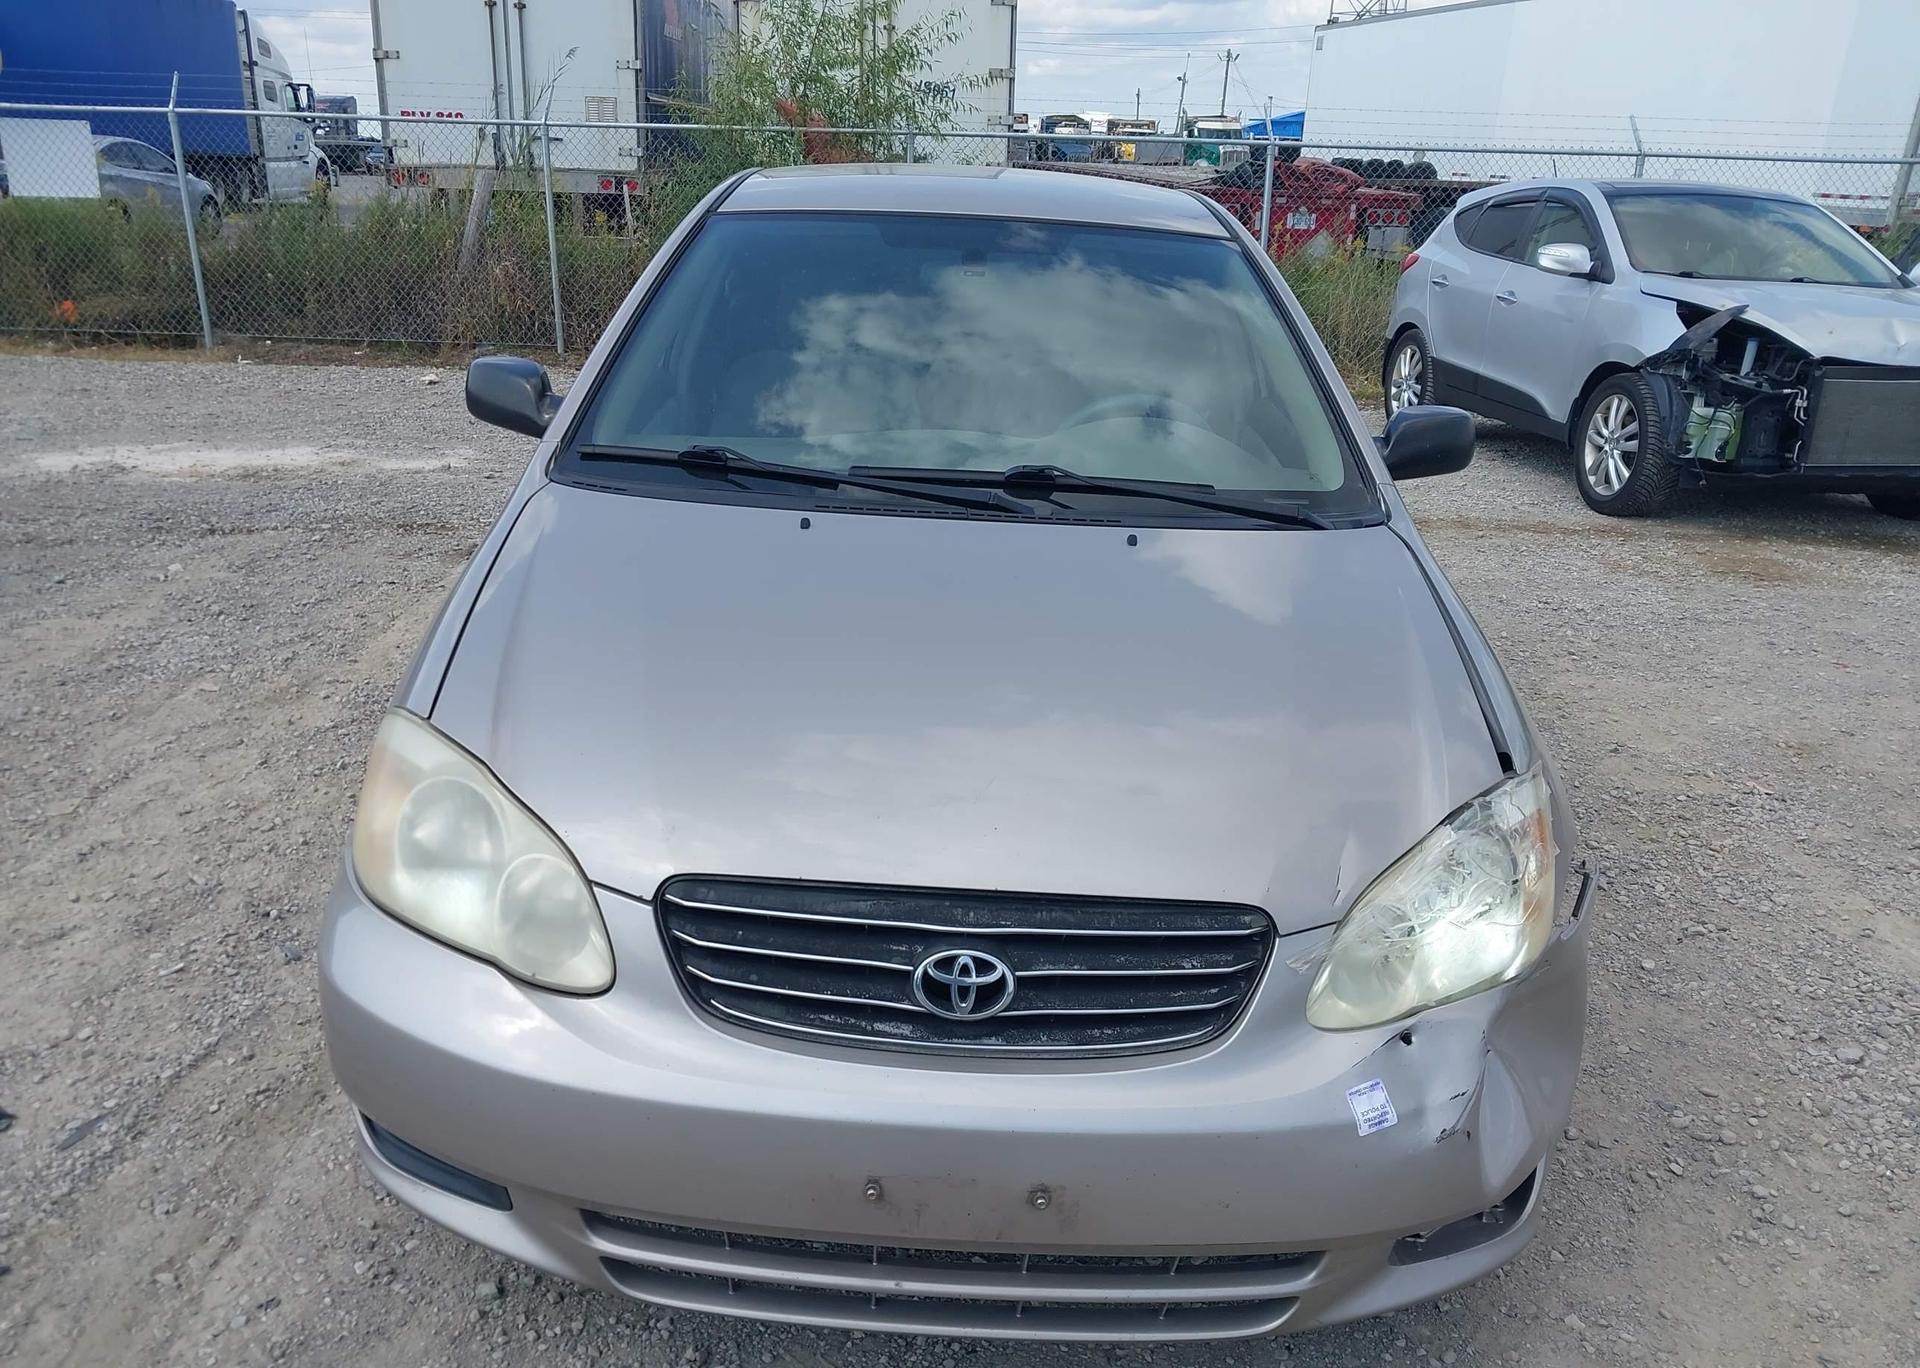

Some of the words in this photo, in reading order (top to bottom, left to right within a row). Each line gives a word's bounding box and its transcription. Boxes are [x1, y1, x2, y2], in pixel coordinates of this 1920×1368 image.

[1361, 1106, 1380, 1118] POLICE
[1363, 1110, 1390, 1124] REPORTED
[1368, 1118, 1389, 1130] DAMAGE
